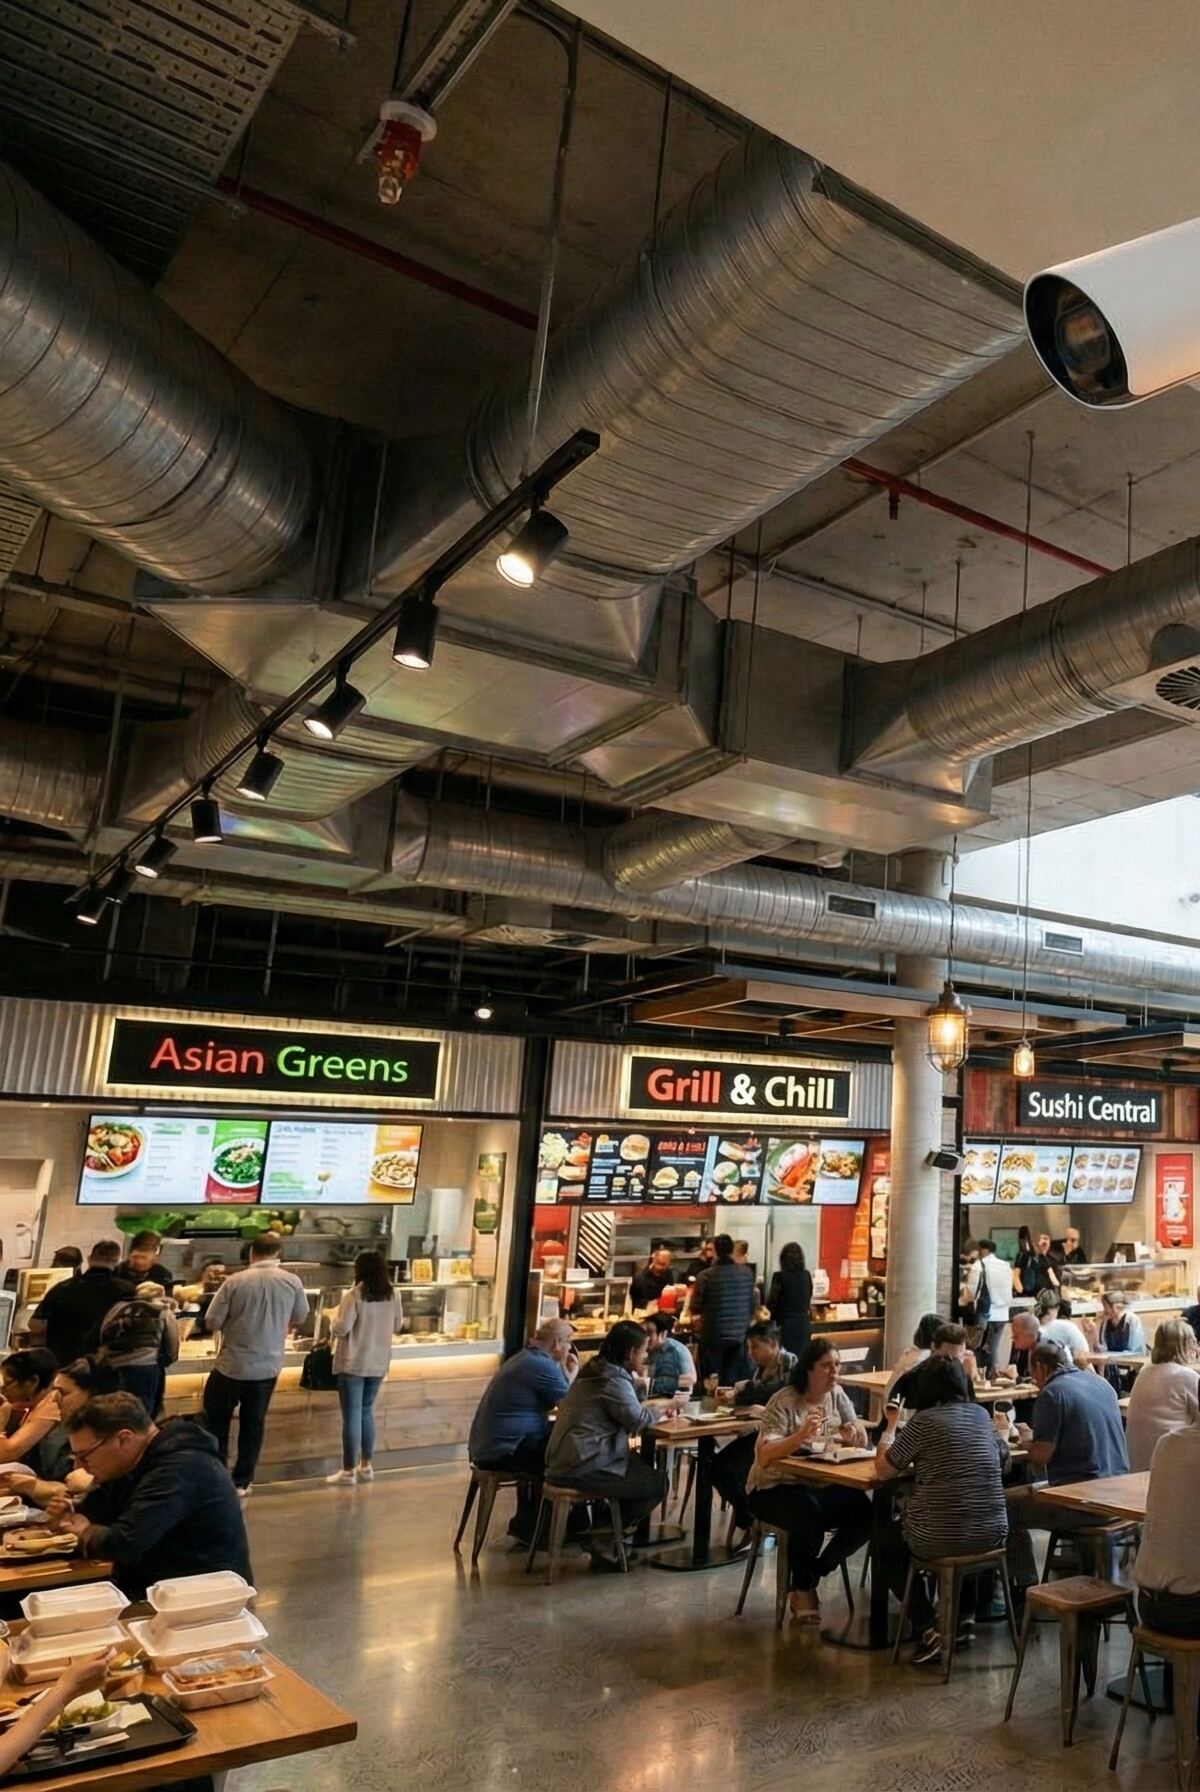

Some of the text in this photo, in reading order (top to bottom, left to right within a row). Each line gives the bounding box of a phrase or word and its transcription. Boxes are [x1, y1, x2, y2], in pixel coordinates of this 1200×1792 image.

[150, 1038, 408, 1083] Asian Greens
[647, 1068, 834, 1109] Grill & Chill
[1028, 1091, 1156, 1123] Sushi Central
